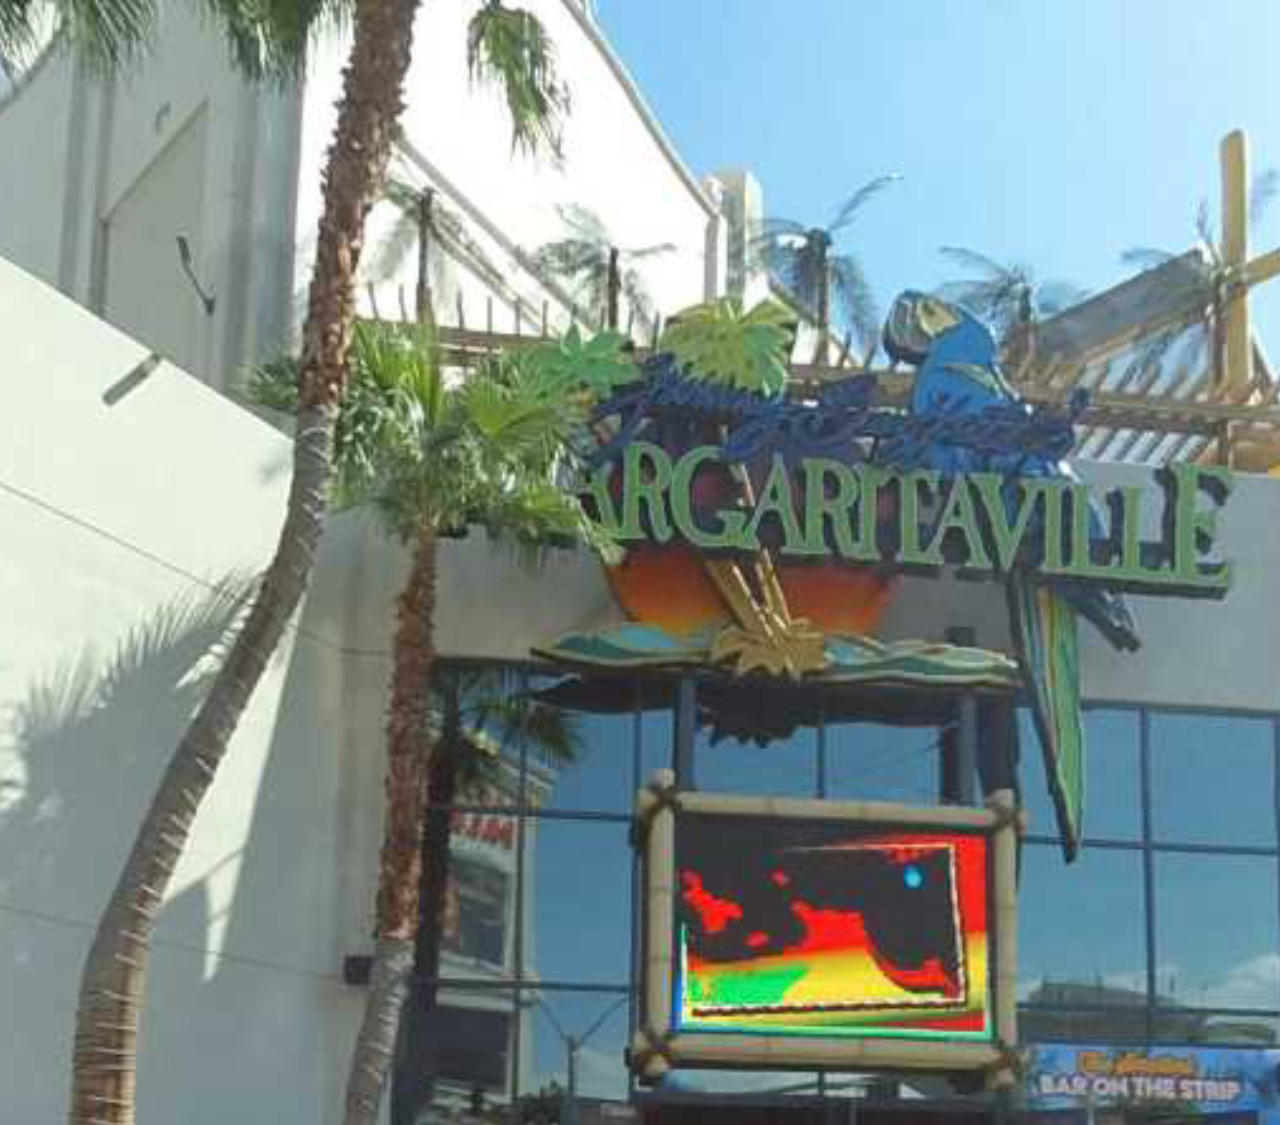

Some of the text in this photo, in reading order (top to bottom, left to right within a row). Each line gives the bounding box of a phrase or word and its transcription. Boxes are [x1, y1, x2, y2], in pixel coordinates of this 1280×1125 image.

[582, 440, 1232, 588] ARGARITAVILLE
[1132, 1076, 1176, 1099] THE
[1179, 1078, 1242, 1102] STRIP
